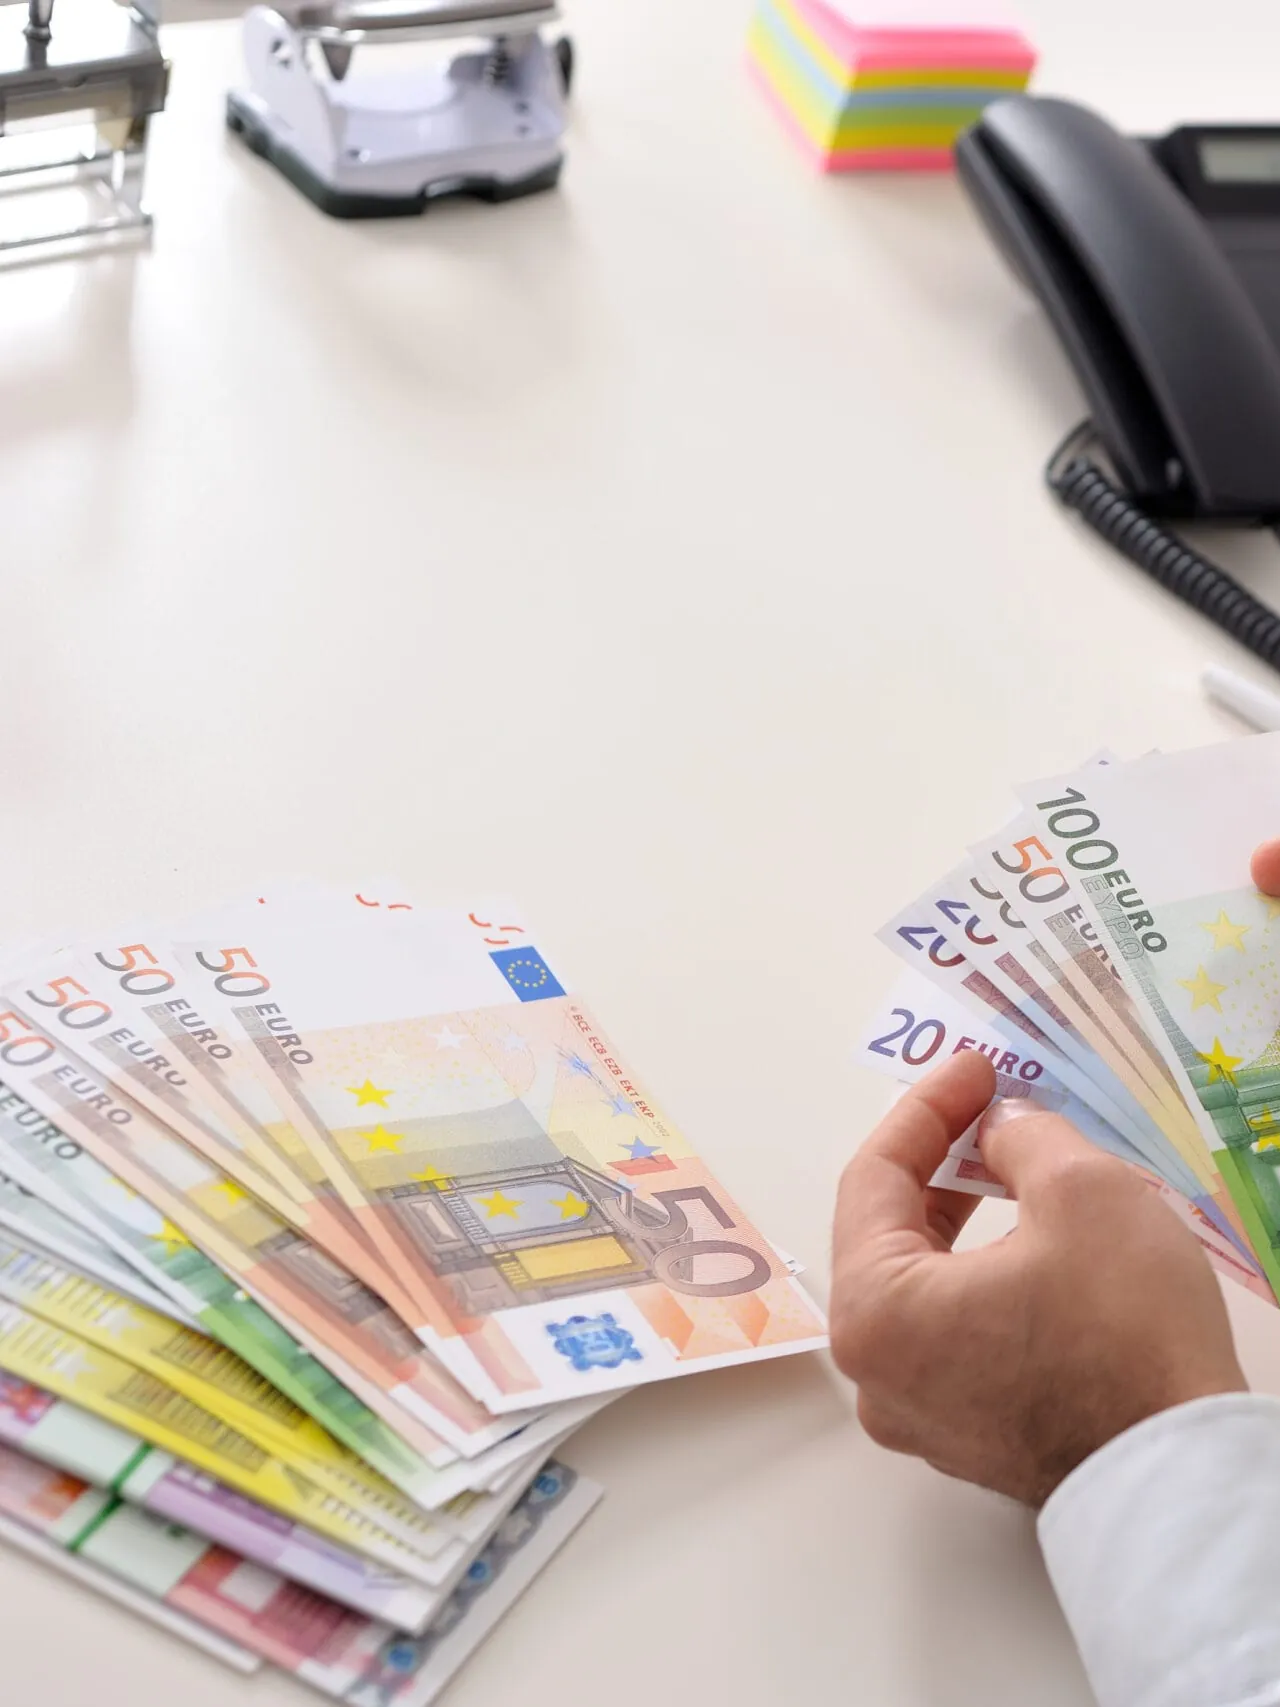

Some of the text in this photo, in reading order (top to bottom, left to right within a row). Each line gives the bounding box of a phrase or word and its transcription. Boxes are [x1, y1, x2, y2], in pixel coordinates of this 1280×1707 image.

[991, 836, 1070, 903] 50
[1064, 904, 1122, 981] EU
[1036, 787, 1119, 870] 100
[1103, 869, 1167, 953] EURO
[26, 976, 112, 1029] 50
[94, 943, 232, 1060] 50 EURO
[195, 947, 313, 1065] 50 EURO
[868, 1008, 946, 1066] 20
[52, 1064, 132, 1125] EURO
[573, 1014, 591, 1033] BCE
[588, 1036, 607, 1055] ECB
[604, 1057, 622, 1076] EZB
[620, 1079, 639, 1097] EKT
[635, 1100, 654, 1119] EKP
[601, 1186, 771, 1298] 50
